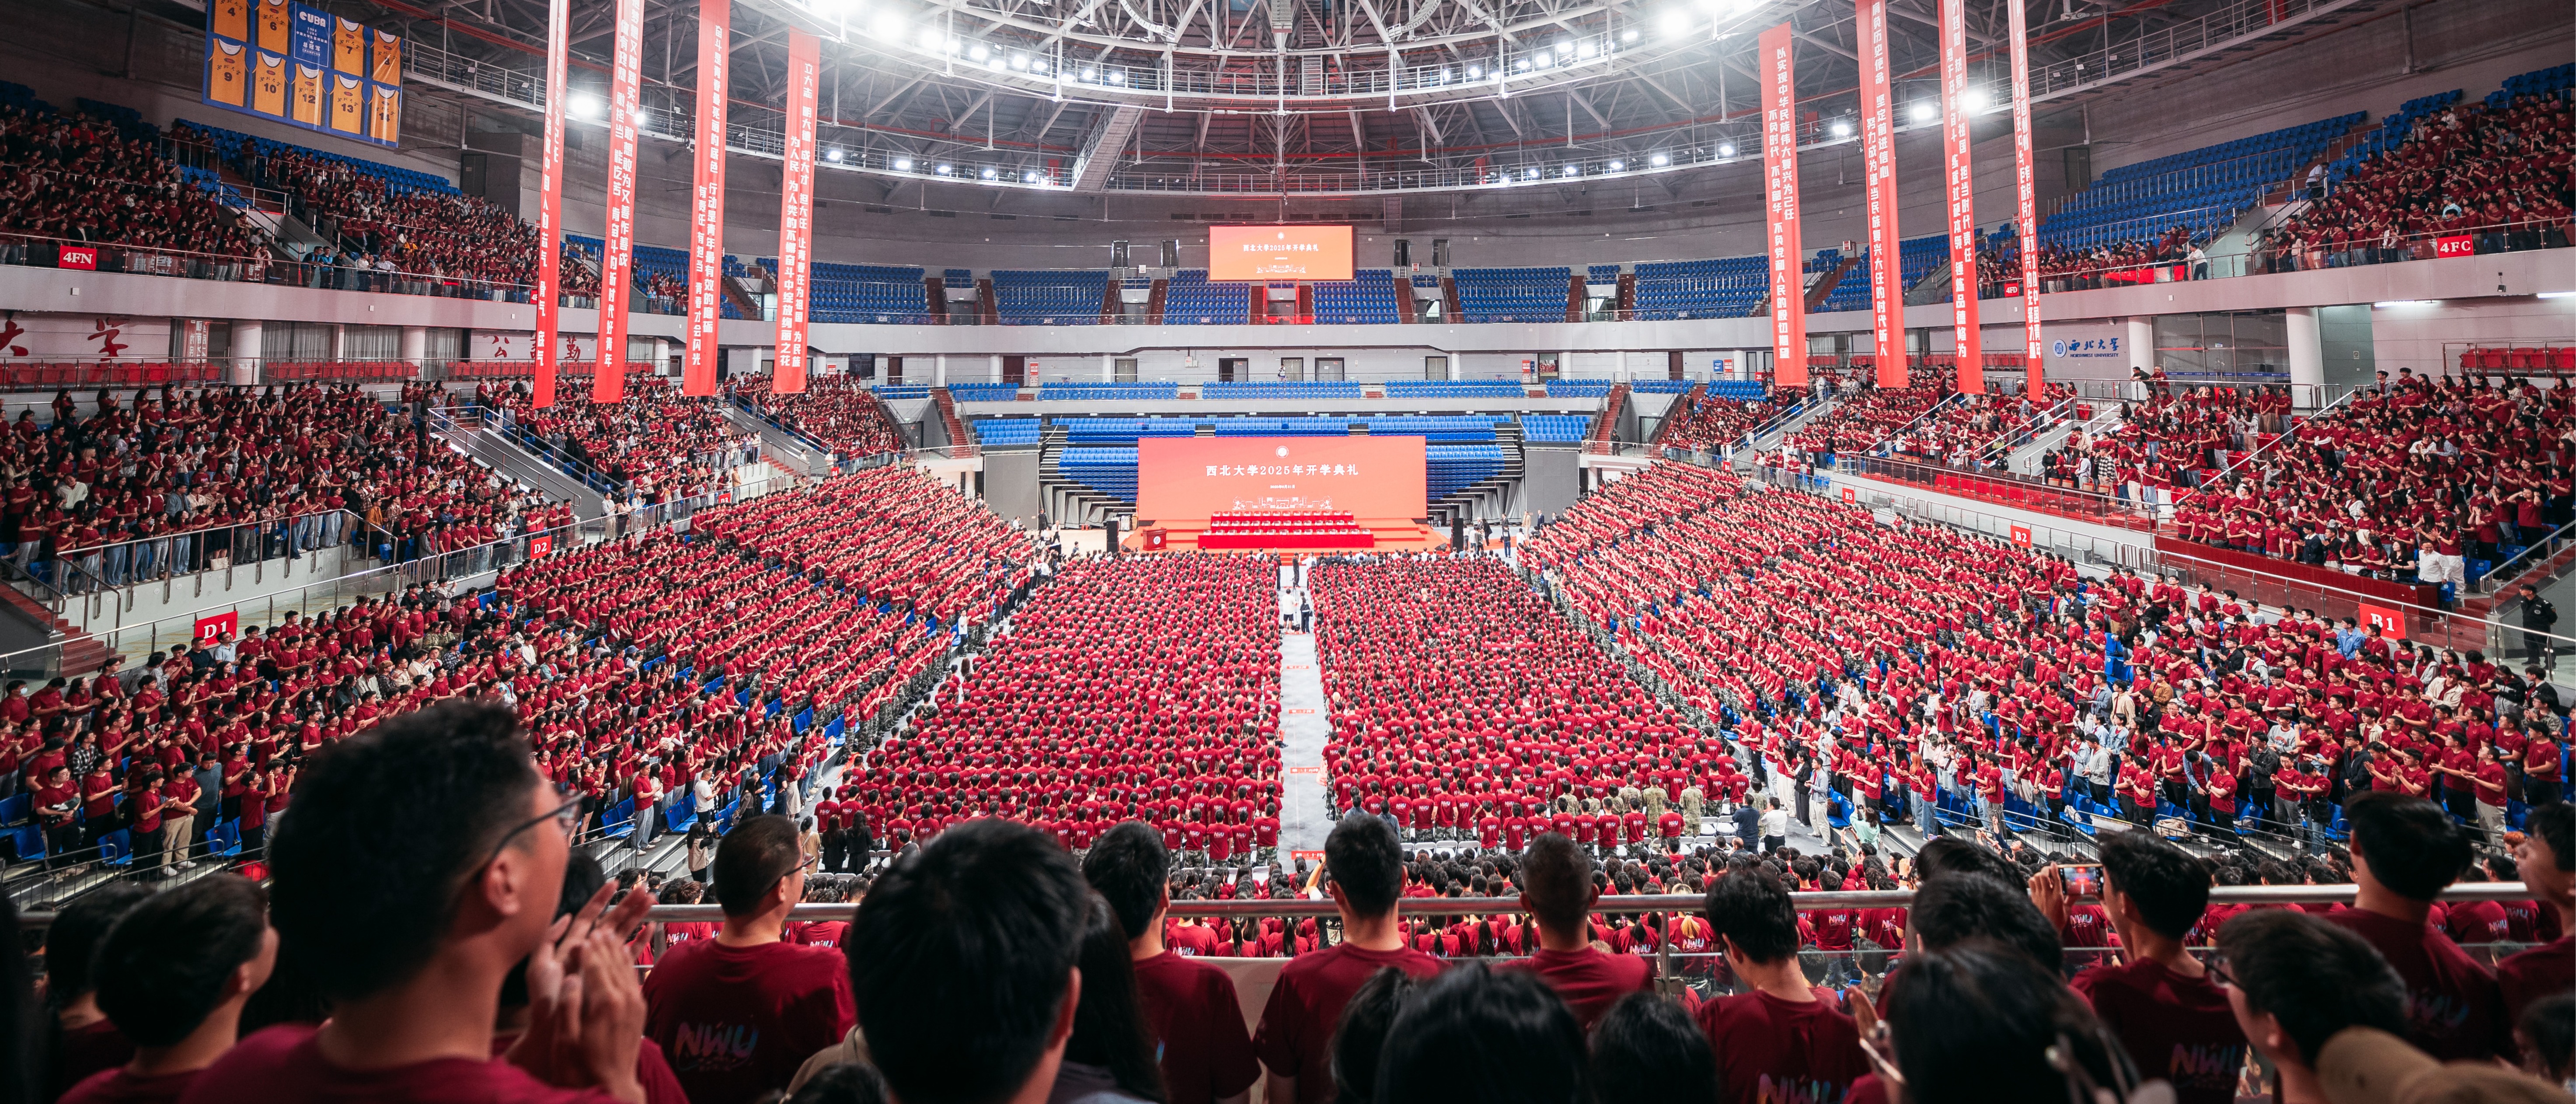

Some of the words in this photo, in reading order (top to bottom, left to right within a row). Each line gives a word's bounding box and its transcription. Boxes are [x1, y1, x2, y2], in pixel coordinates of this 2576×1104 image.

[227, 7, 236, 17] 4
[270, 21, 277, 31] 6
[299, 11, 326, 27] CUBA
[346, 45, 352, 54] 7
[618, 19, 629, 83] 做有理想
[1872, 1, 1885, 85] 肩负历史使命
[224, 72, 233, 82] 9
[264, 83, 276, 94] 10
[803, 63, 813, 99] 立大志
[1947, 47, 1957, 143] 勇于砥砺奋斗
[303, 94, 316, 104] 12
[341, 103, 353, 113] 13
[616, 91, 625, 139] 敢担当
[710, 24, 722, 174] 奋斗是青春最亮丽的底色
[1955, 56, 1966, 154] 热爱伟大祖国
[802, 105, 812, 143] 明大德
[1768, 108, 1779, 158] 不负时代
[1777, 46, 1794, 220] 以实现中华民族伟大复兴为己任
[1876, 93, 1889, 179] 坚定前进信心
[613, 148, 623, 196] 能吃苦
[790, 136, 800, 173] 为人民
[800, 150, 810, 185] 成大才
[619, 126, 634, 267] 敢想敢为又善作善成
[698, 185, 707, 227] 有责任
[1771, 164, 1783, 214] 不负韶华
[1951, 154, 1963, 250] 练就过硬本领
[798, 192, 809, 230] 担大任
[1960, 164, 1972, 262] 担当时代责任
[696, 231, 705, 273] 有担当
[1866, 116, 1888, 357] 努力成为堪当民族复兴大任的时代新人
[2440, 240, 2471, 253] 4FC
[63, 252, 93, 264] 4FN
[703, 182, 718, 333] 行动是青年最有效的磨砺
[780, 179, 798, 367] 为人类的不懈奋斗中绽放绚丽之花
[539, 280, 546, 316] 骨气
[604, 206, 620, 367] 肯奋斗的新时代好青年
[795, 237, 806, 323] 让青春在为祖国
[1773, 222, 1790, 359] 不负党和人民的殷切期望
[692, 282, 702, 366] 青春才会闪光
[1955, 261, 1967, 358] 锤炼品德修为
[537, 330, 545, 366] 底气
[792, 331, 802, 367] 为民族
[2069, 338, 2119, 351] 西北大学
[1206, 464, 1359, 476] 西北大学2025年开学典礼
[1845, 492, 1852, 500] B3
[534, 542, 547, 554] D2
[2015, 531, 2027, 542] B2
[204, 621, 227, 639] D1
[2370, 613, 2395, 632] B1
[1829, 914, 1846, 922] NWU
[2071, 914, 2092, 924] NWU
[2489, 919, 2507, 932] NWU
[666, 932, 688, 943] NWU
[1629, 944, 1651, 954] NWU
[1682, 937, 1705, 948] NWU
[675, 1022, 759, 1057] NWU
